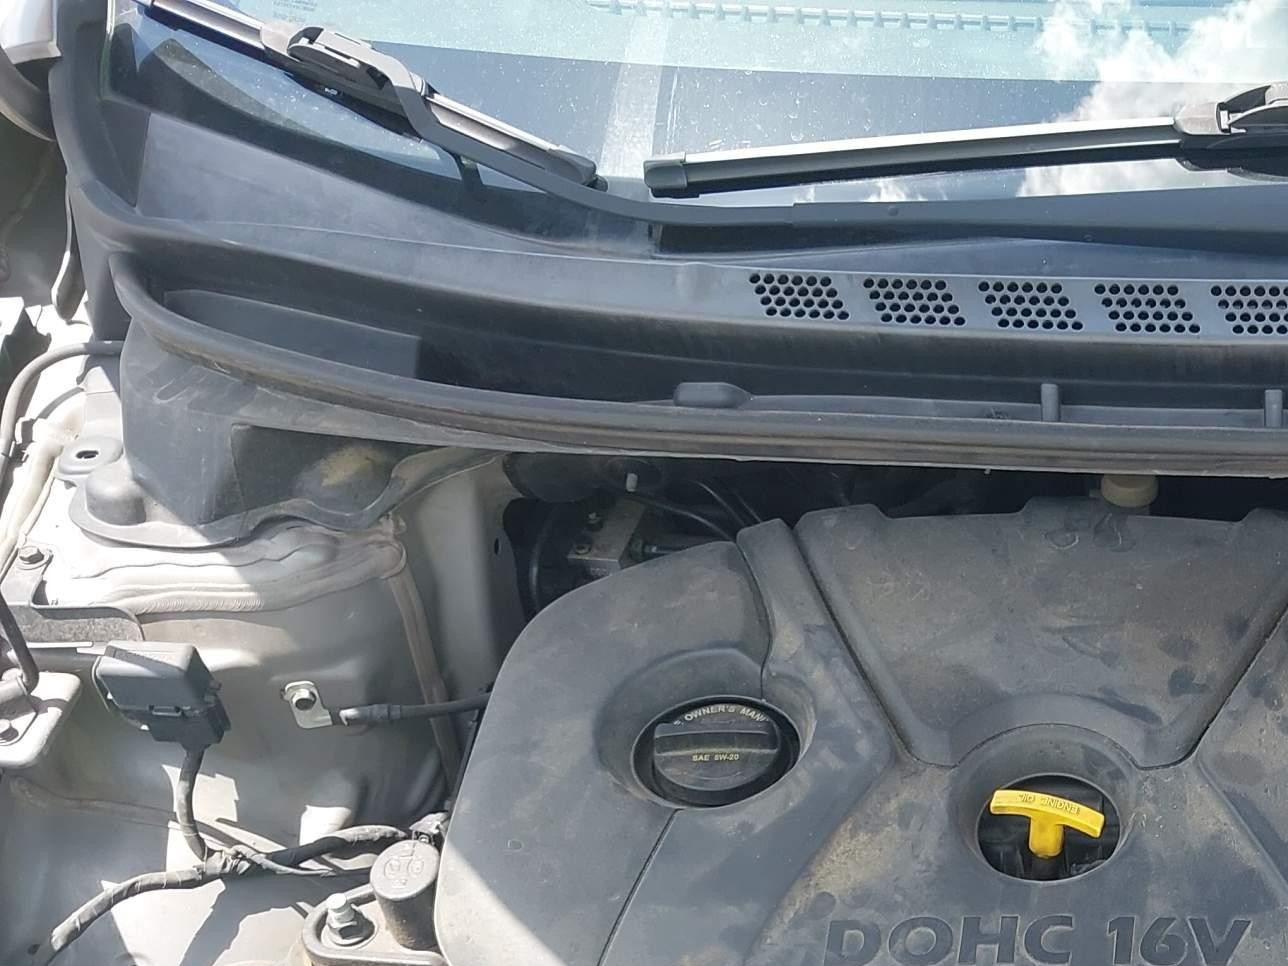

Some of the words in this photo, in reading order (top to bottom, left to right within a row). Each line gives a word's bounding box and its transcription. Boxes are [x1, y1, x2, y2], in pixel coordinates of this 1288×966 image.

[684, 704, 736, 721] OWNER'S
[714, 753, 740, 761] 5W-20
[1018, 792, 1036, 803] OIL
[1041, 797, 1081, 816] ENGINE
